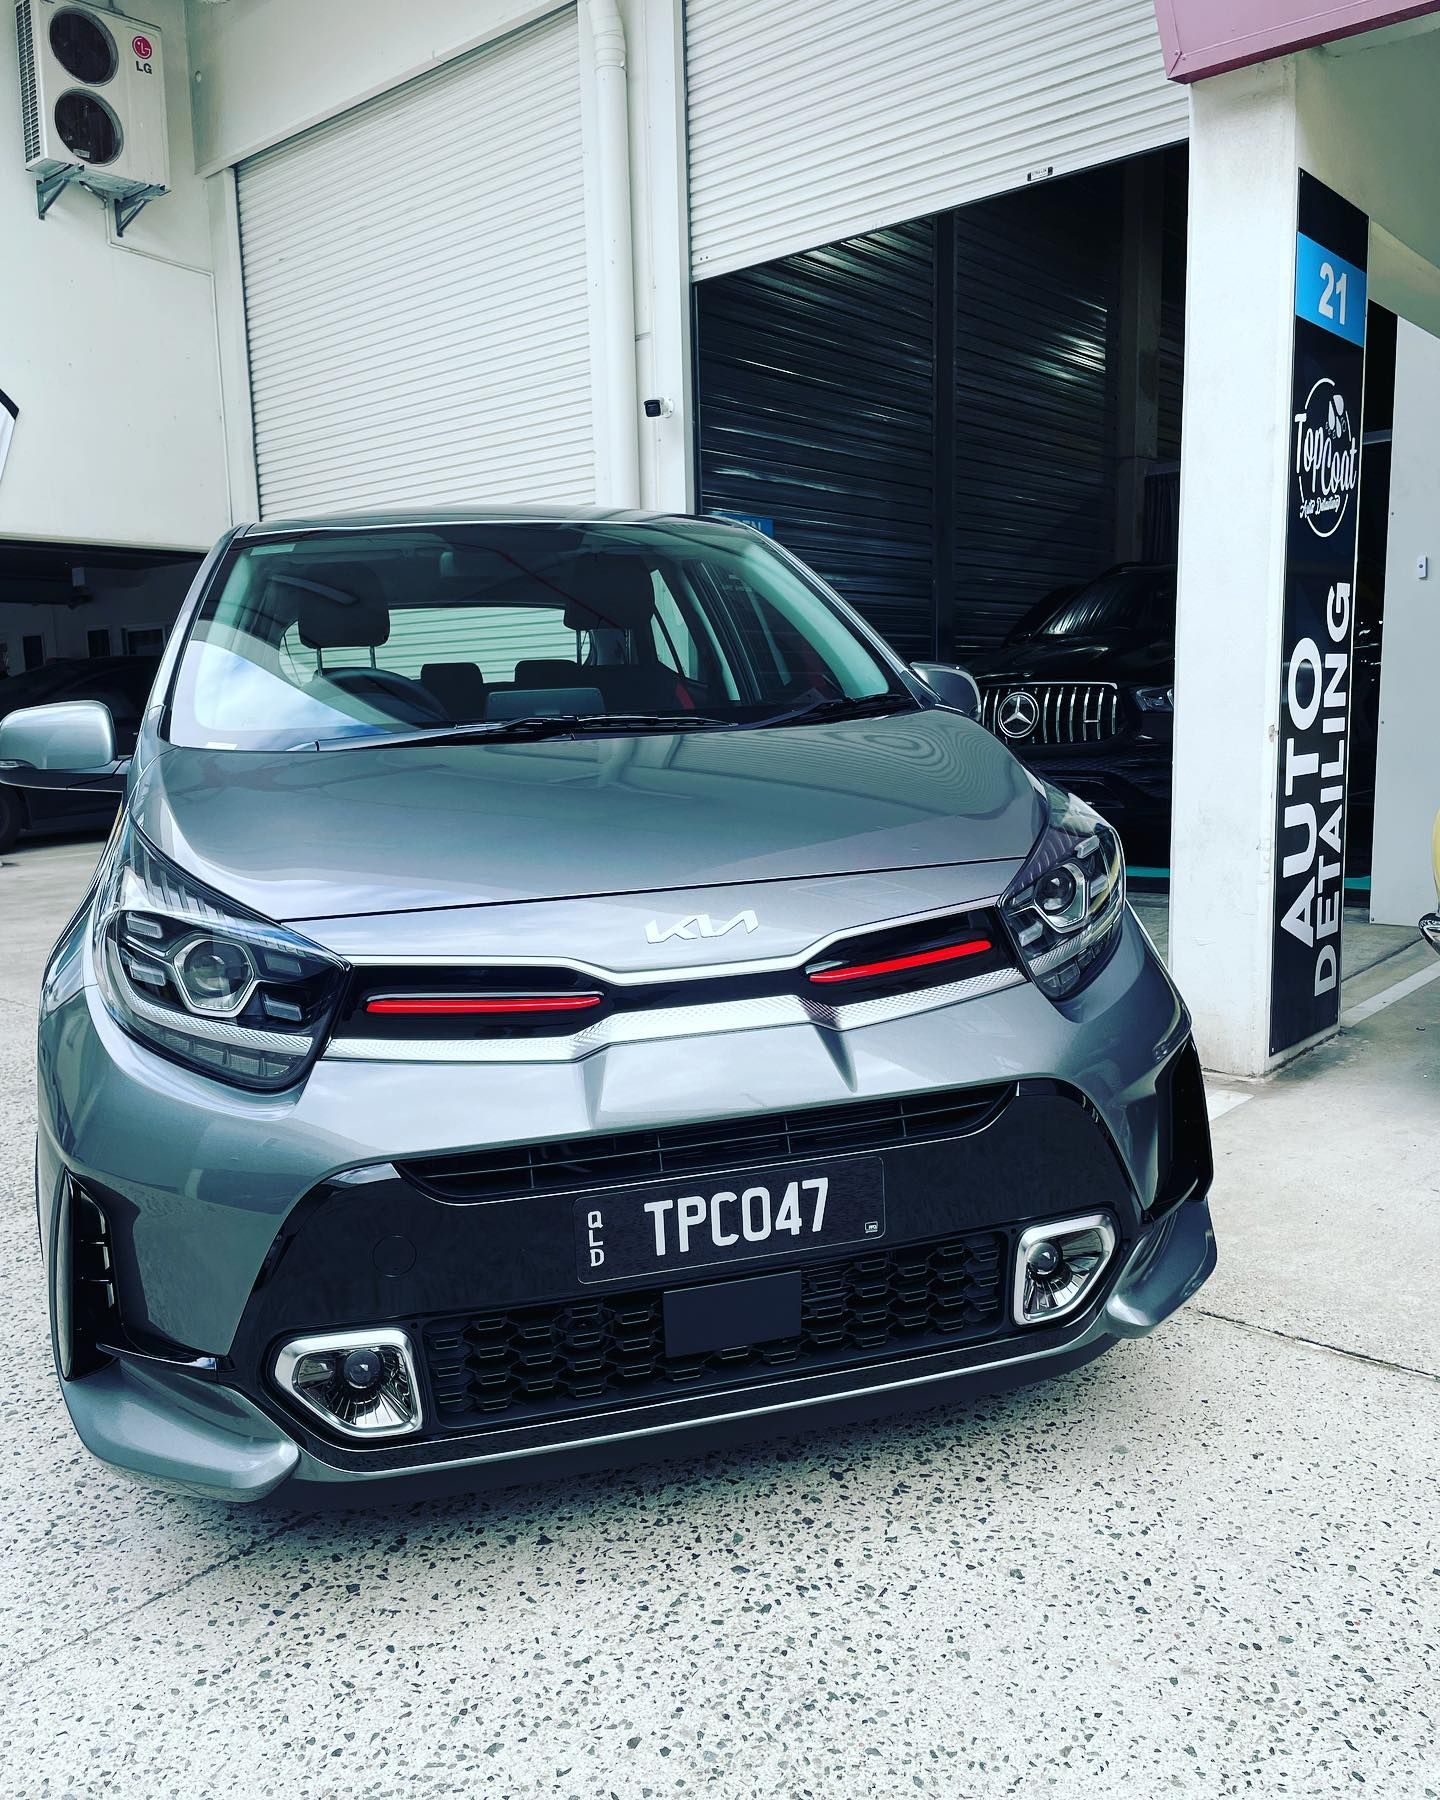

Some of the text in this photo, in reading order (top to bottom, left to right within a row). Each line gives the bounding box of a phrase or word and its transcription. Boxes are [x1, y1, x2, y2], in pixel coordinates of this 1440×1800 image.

[136, 61, 152, 74] LG
[1319, 262, 1347, 325] 21
[1281, 637, 1322, 948] AUTO
[1314, 582, 1350, 997] DETAILING
[644, 910, 759, 944] KIA
[588, 1211, 604, 1266] QLD
